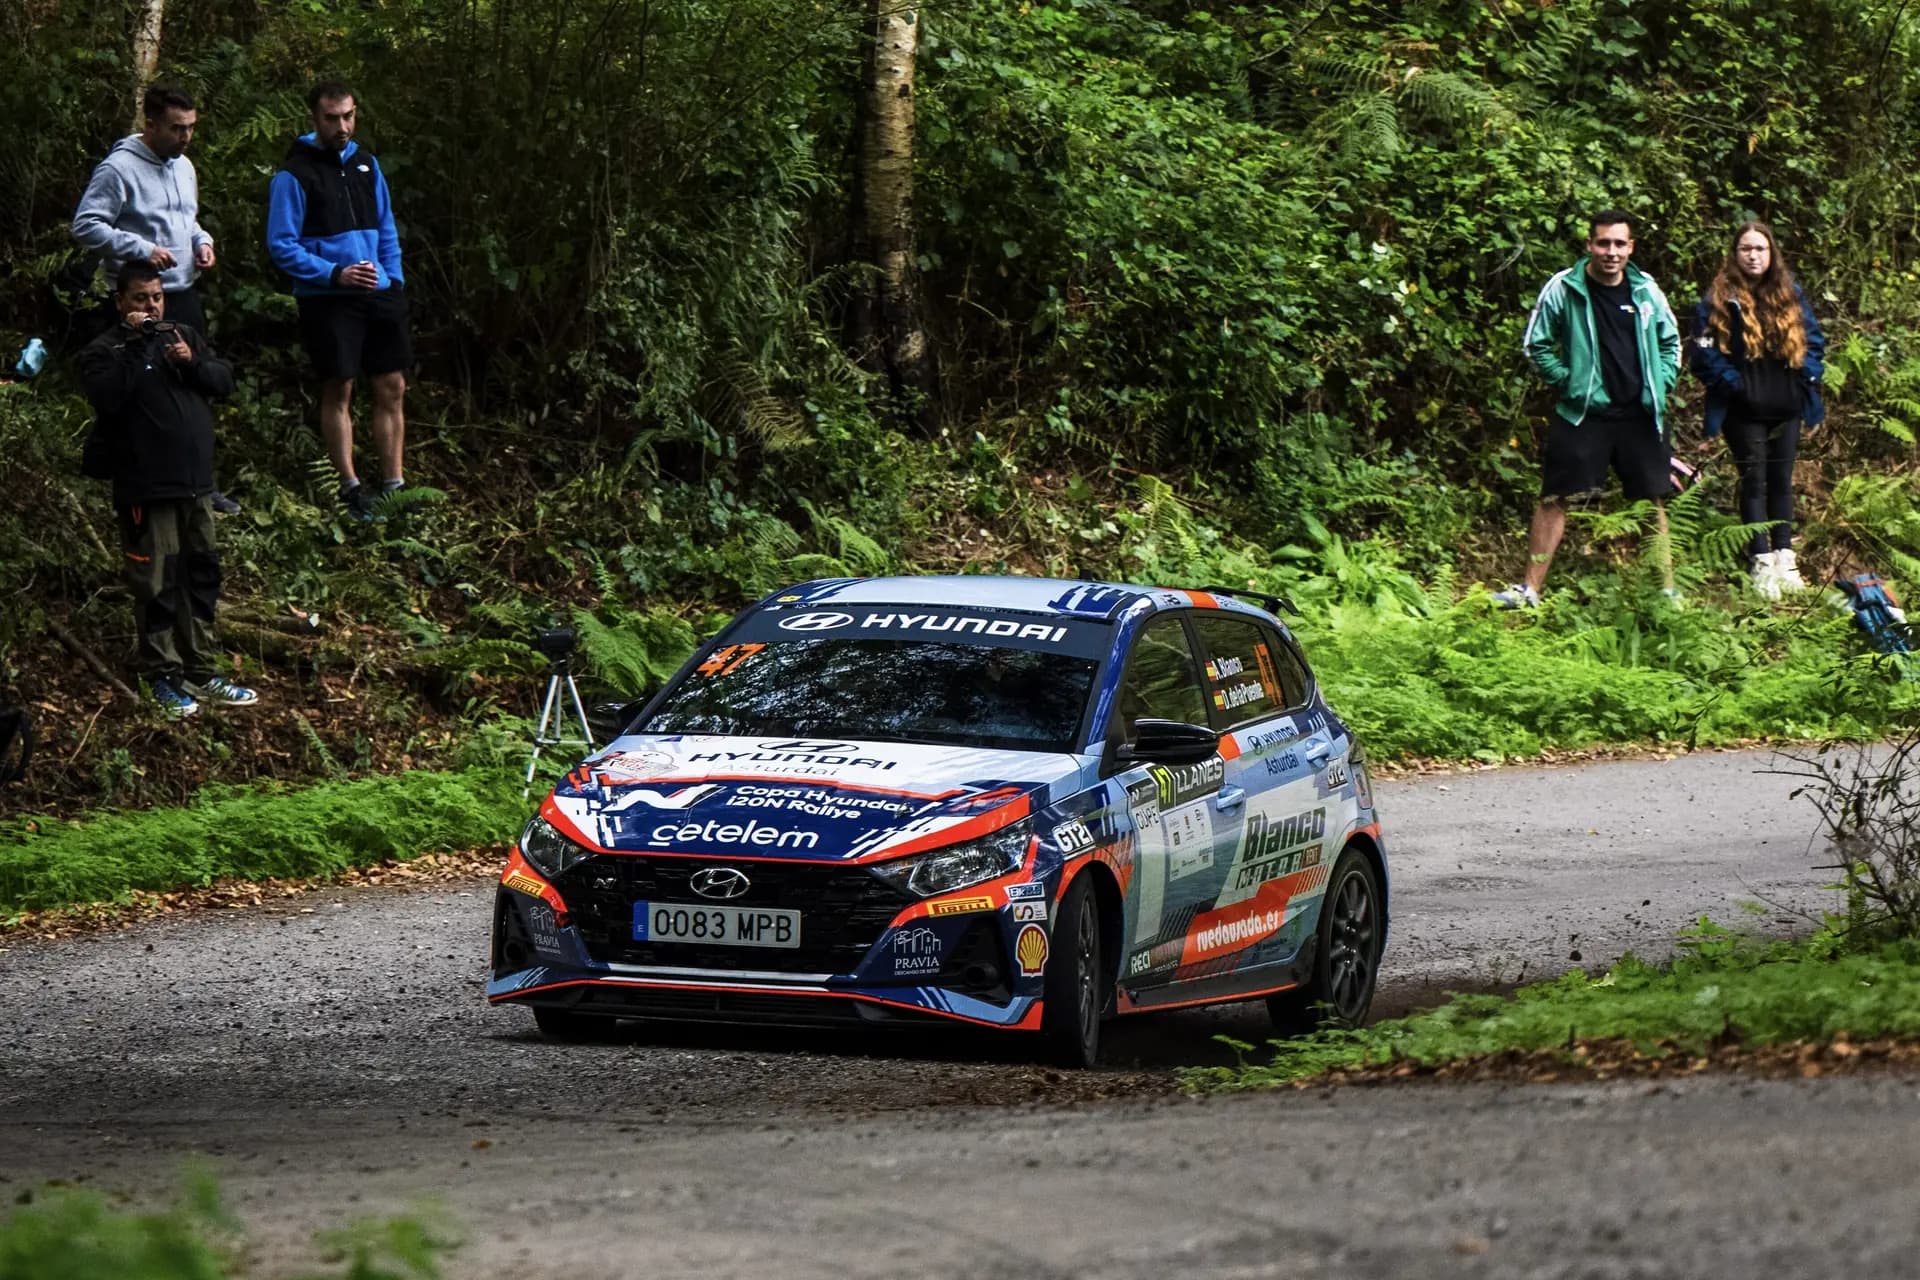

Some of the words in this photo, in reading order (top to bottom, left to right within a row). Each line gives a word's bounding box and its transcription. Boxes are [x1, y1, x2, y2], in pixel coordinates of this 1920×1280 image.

[860, 612, 1068, 643] HYUNDAI
[697, 643, 767, 678] 47
[688, 752, 898, 771] HYUNDAI
[718, 763, 841, 777] Asturdai
[1264, 748, 1300, 777] Asturdai
[1152, 766, 1172, 805] 47
[1175, 756, 1224, 794] LLANES
[736, 785, 802, 800] Copa
[726, 796, 787, 811] i20N
[787, 800, 861, 820] Rallye
[648, 820, 819, 848] cetelem
[1242, 806, 1327, 864] Blanco
[1238, 852, 1302, 889] MOTOR
[507, 875, 543, 896] PIRELLI
[932, 898, 993, 915] PIRELLI
[637, 924, 645, 933] E
[654, 908, 725, 937] 0083
[737, 913, 792, 943] MPB
[533, 933, 561, 949] PRAVIA
[895, 956, 940, 969] PRAVIA
